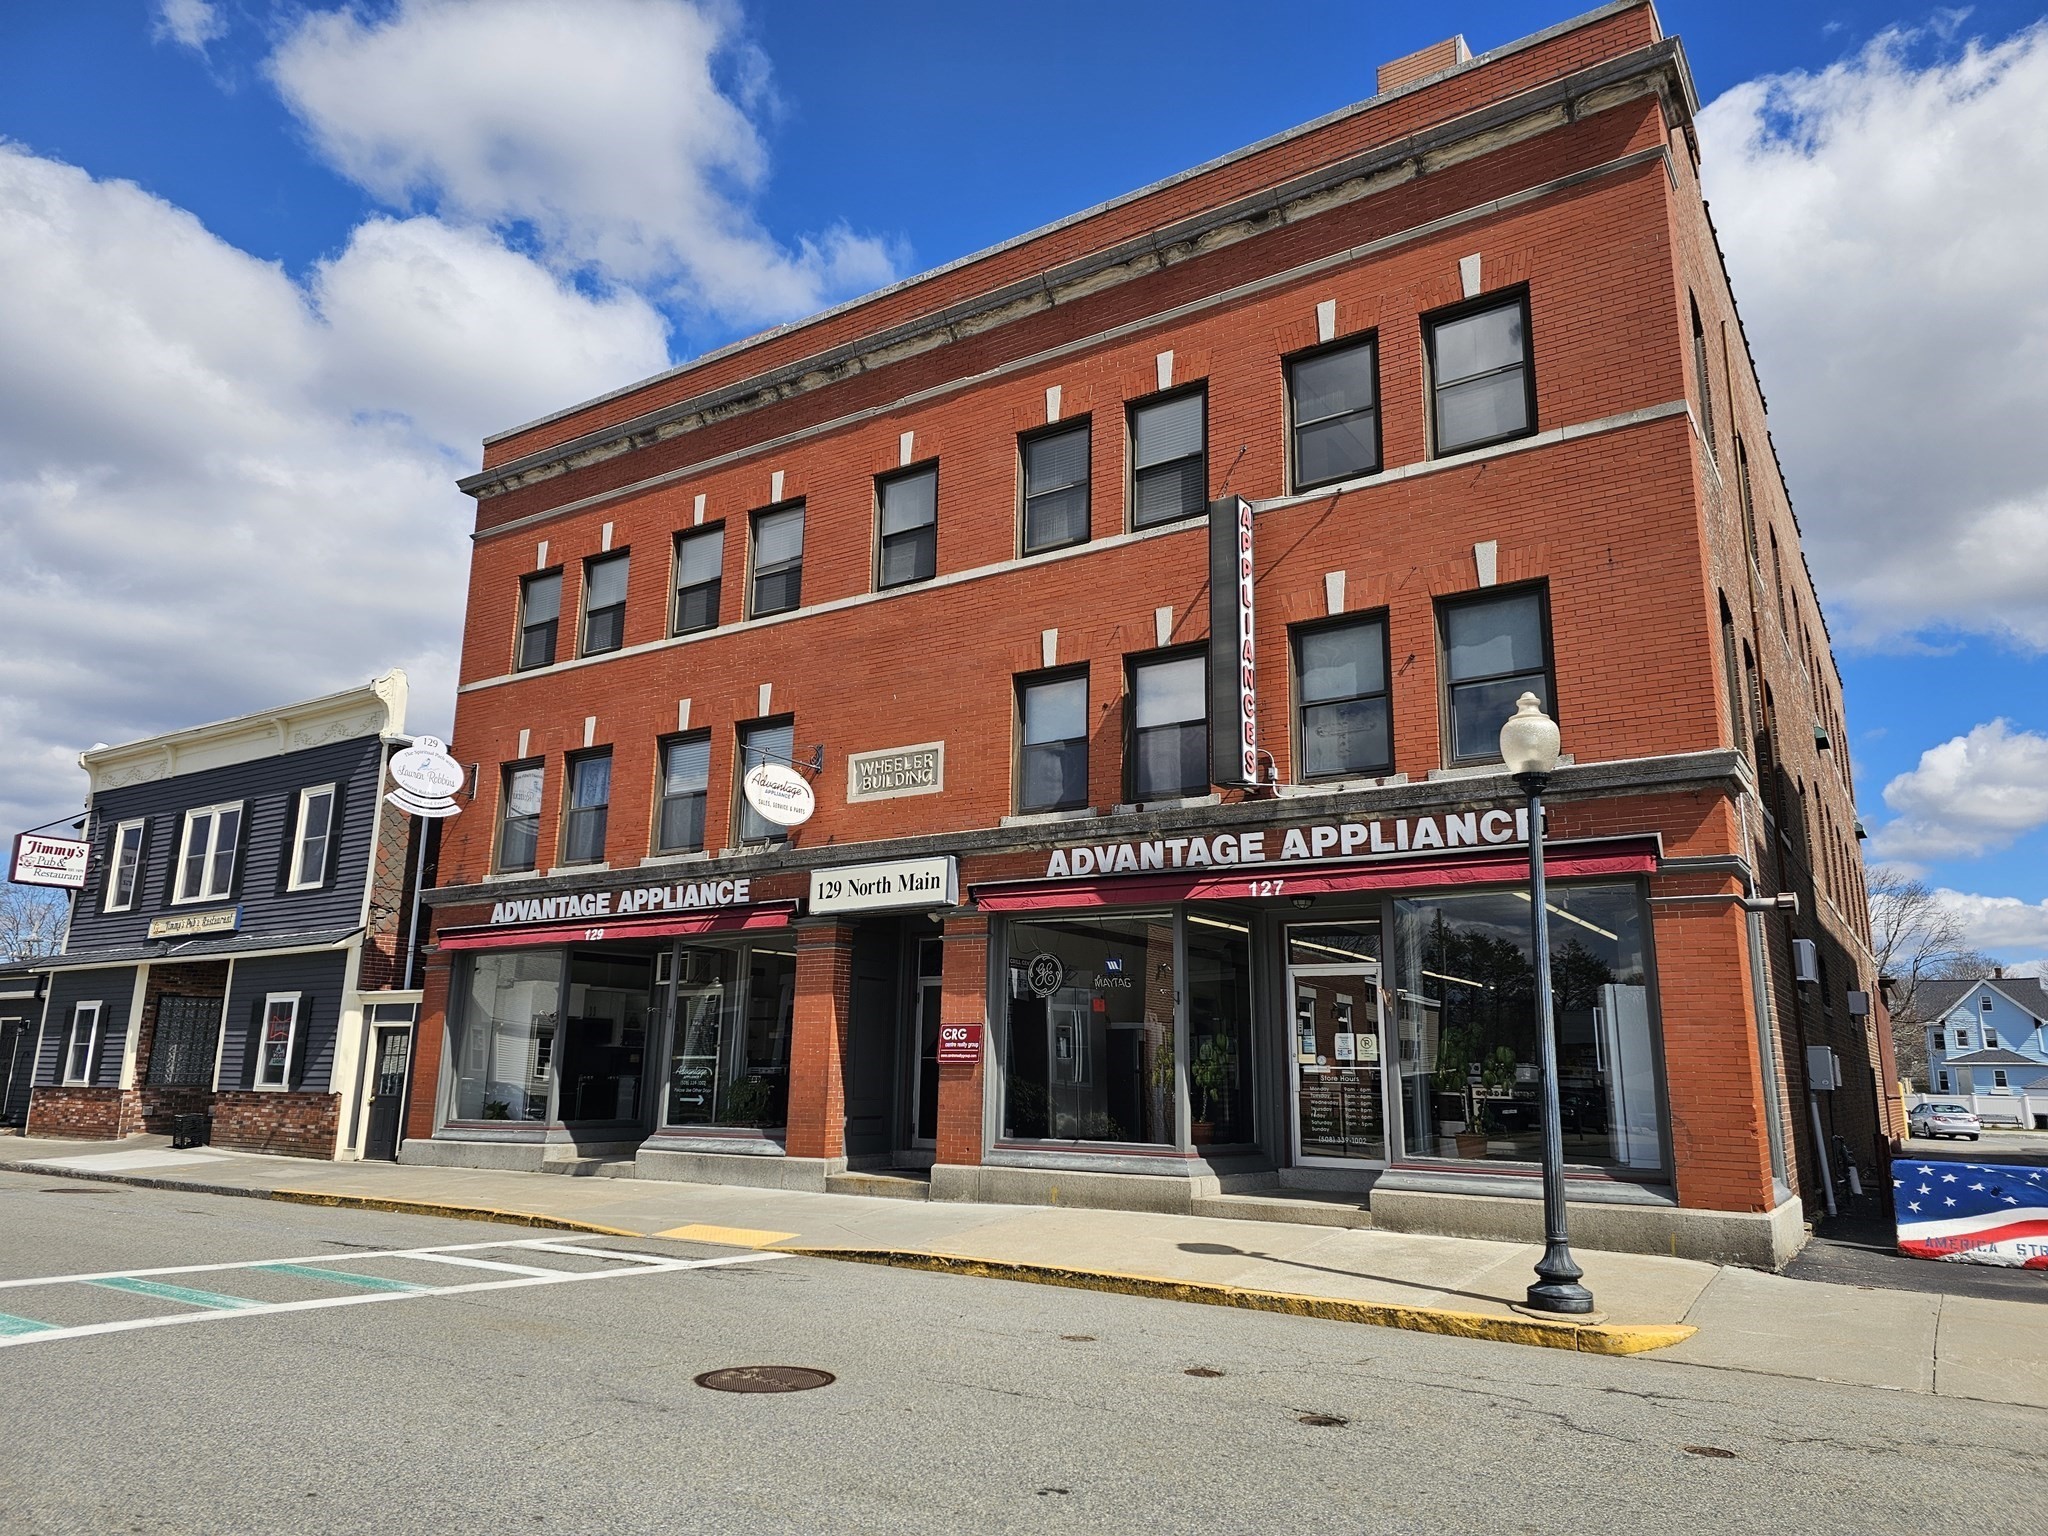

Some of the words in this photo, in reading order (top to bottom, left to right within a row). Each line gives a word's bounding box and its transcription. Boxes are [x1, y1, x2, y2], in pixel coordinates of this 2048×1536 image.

[1240, 506, 1255, 775] APPLIANCES
[423, 737, 439, 748] 129
[404, 750, 413, 758] The
[435, 751, 445, 761] Path
[445, 759, 455, 769] with
[860, 753, 933, 776] WHEELER
[397, 764, 424, 781] Lauren
[427, 770, 455, 788] Robbins
[401, 779, 418, 792] Lauren
[751, 772, 802, 798] Advantage
[401, 791, 423, 804] Sessions
[765, 788, 791, 799] APPLIANCE
[758, 798, 771, 808] SALES,
[772, 801, 788, 811] SERVICE
[793, 806, 806, 815] PARTS
[1046, 830, 1266, 877] ADVANTAGE
[1280, 806, 1547, 860] APPLIANCE
[26, 840, 85, 860] Jimmy's
[37, 855, 56, 867] Pub
[56, 858, 66, 868] &
[33, 867, 83, 881] Restaurant
[818, 880, 842, 900] 129
[848, 875, 891, 898] North
[898, 871, 940, 893] Main
[1248, 880, 1284, 897] 127
[490, 892, 611, 924] ADVANTAGE
[617, 879, 750, 914] APPLIANCE
[584, 928, 604, 940] 129
[1094, 975, 1131, 989] MAYTAG
[942, 1028, 967, 1040] CRG
[674, 1065, 707, 1078] Advantage
[1320, 1074, 1338, 1082] Store
[1318, 1135, 1336, 1143] (508)
[1925, 1236, 1998, 1254] AMERICA
